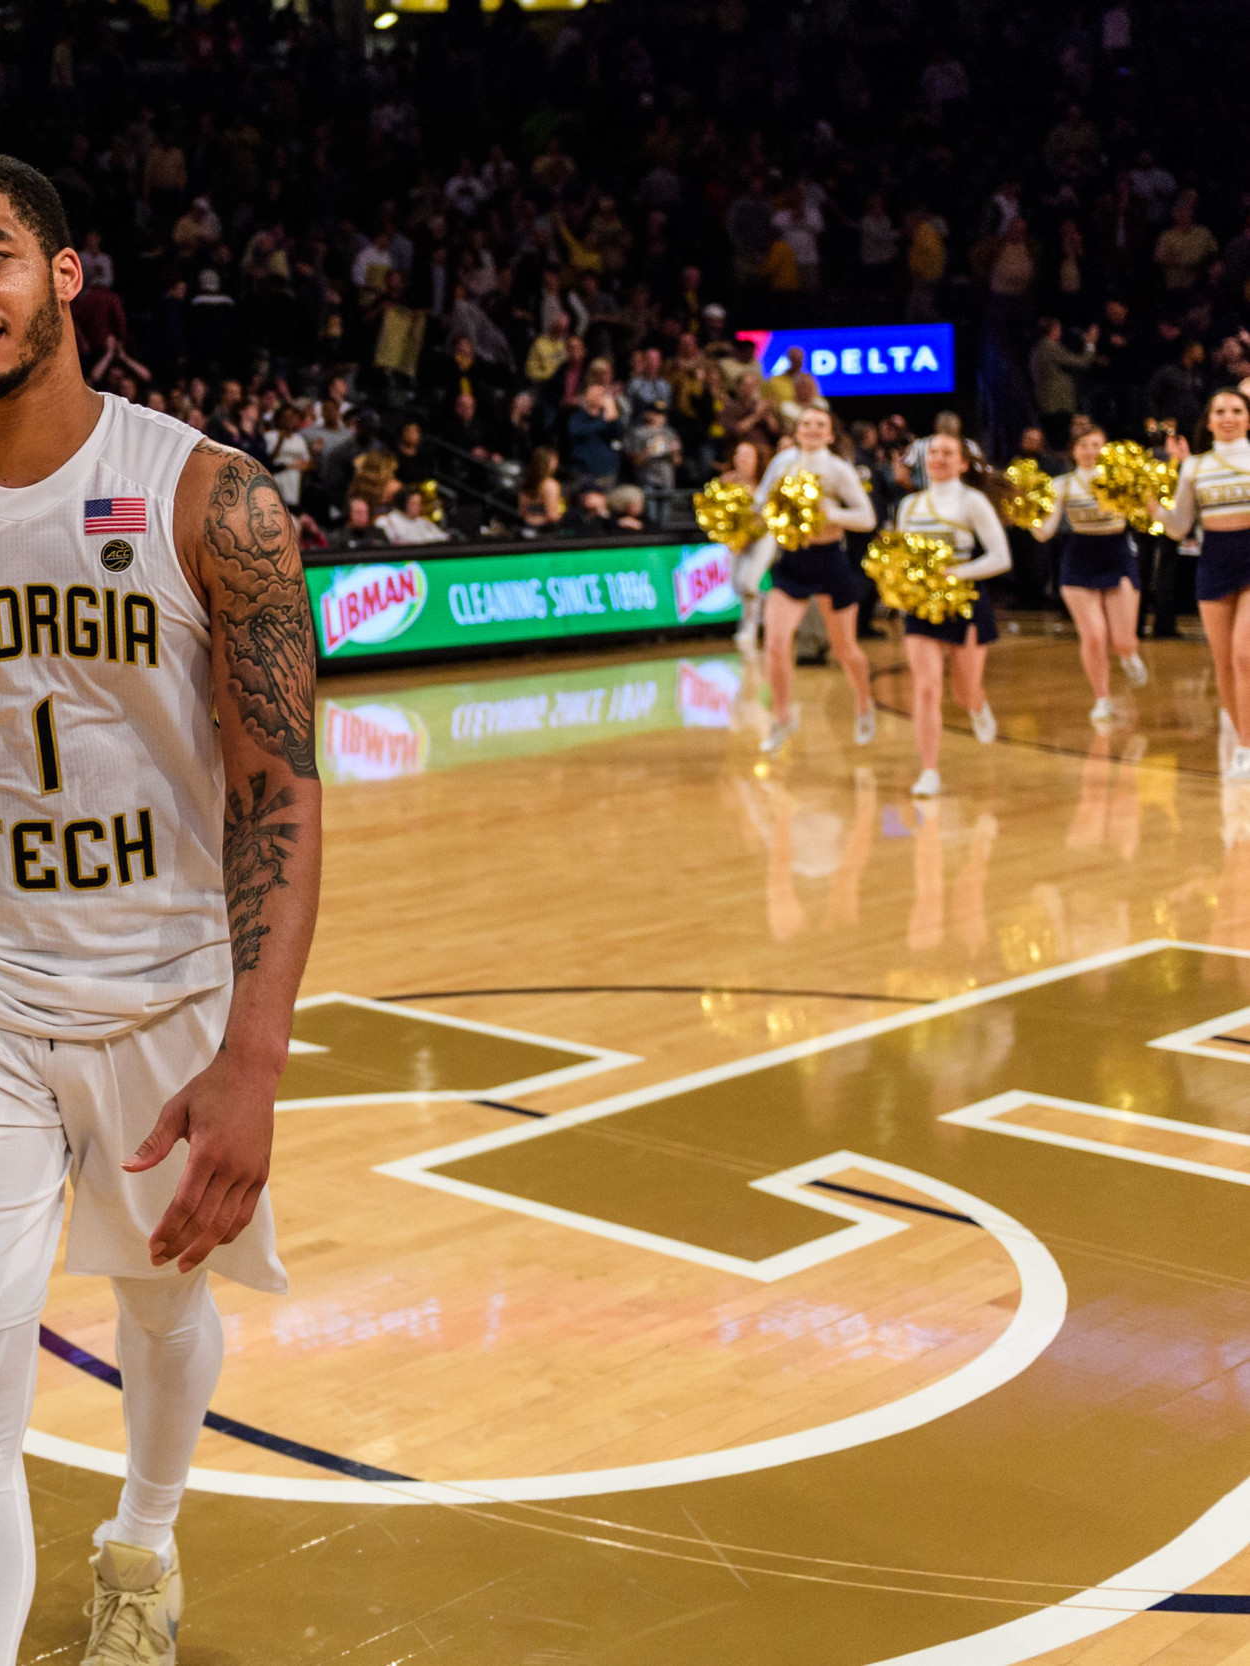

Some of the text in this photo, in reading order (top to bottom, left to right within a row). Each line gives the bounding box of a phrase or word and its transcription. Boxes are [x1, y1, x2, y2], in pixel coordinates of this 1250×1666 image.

[810, 345, 939, 377] DELTA
[106, 550, 130, 559] ACC
[323, 570, 416, 649] LIBMAN
[449, 578, 547, 625] CLEANING
[546, 574, 606, 617] SINCE
[32, 692, 63, 795] 1
